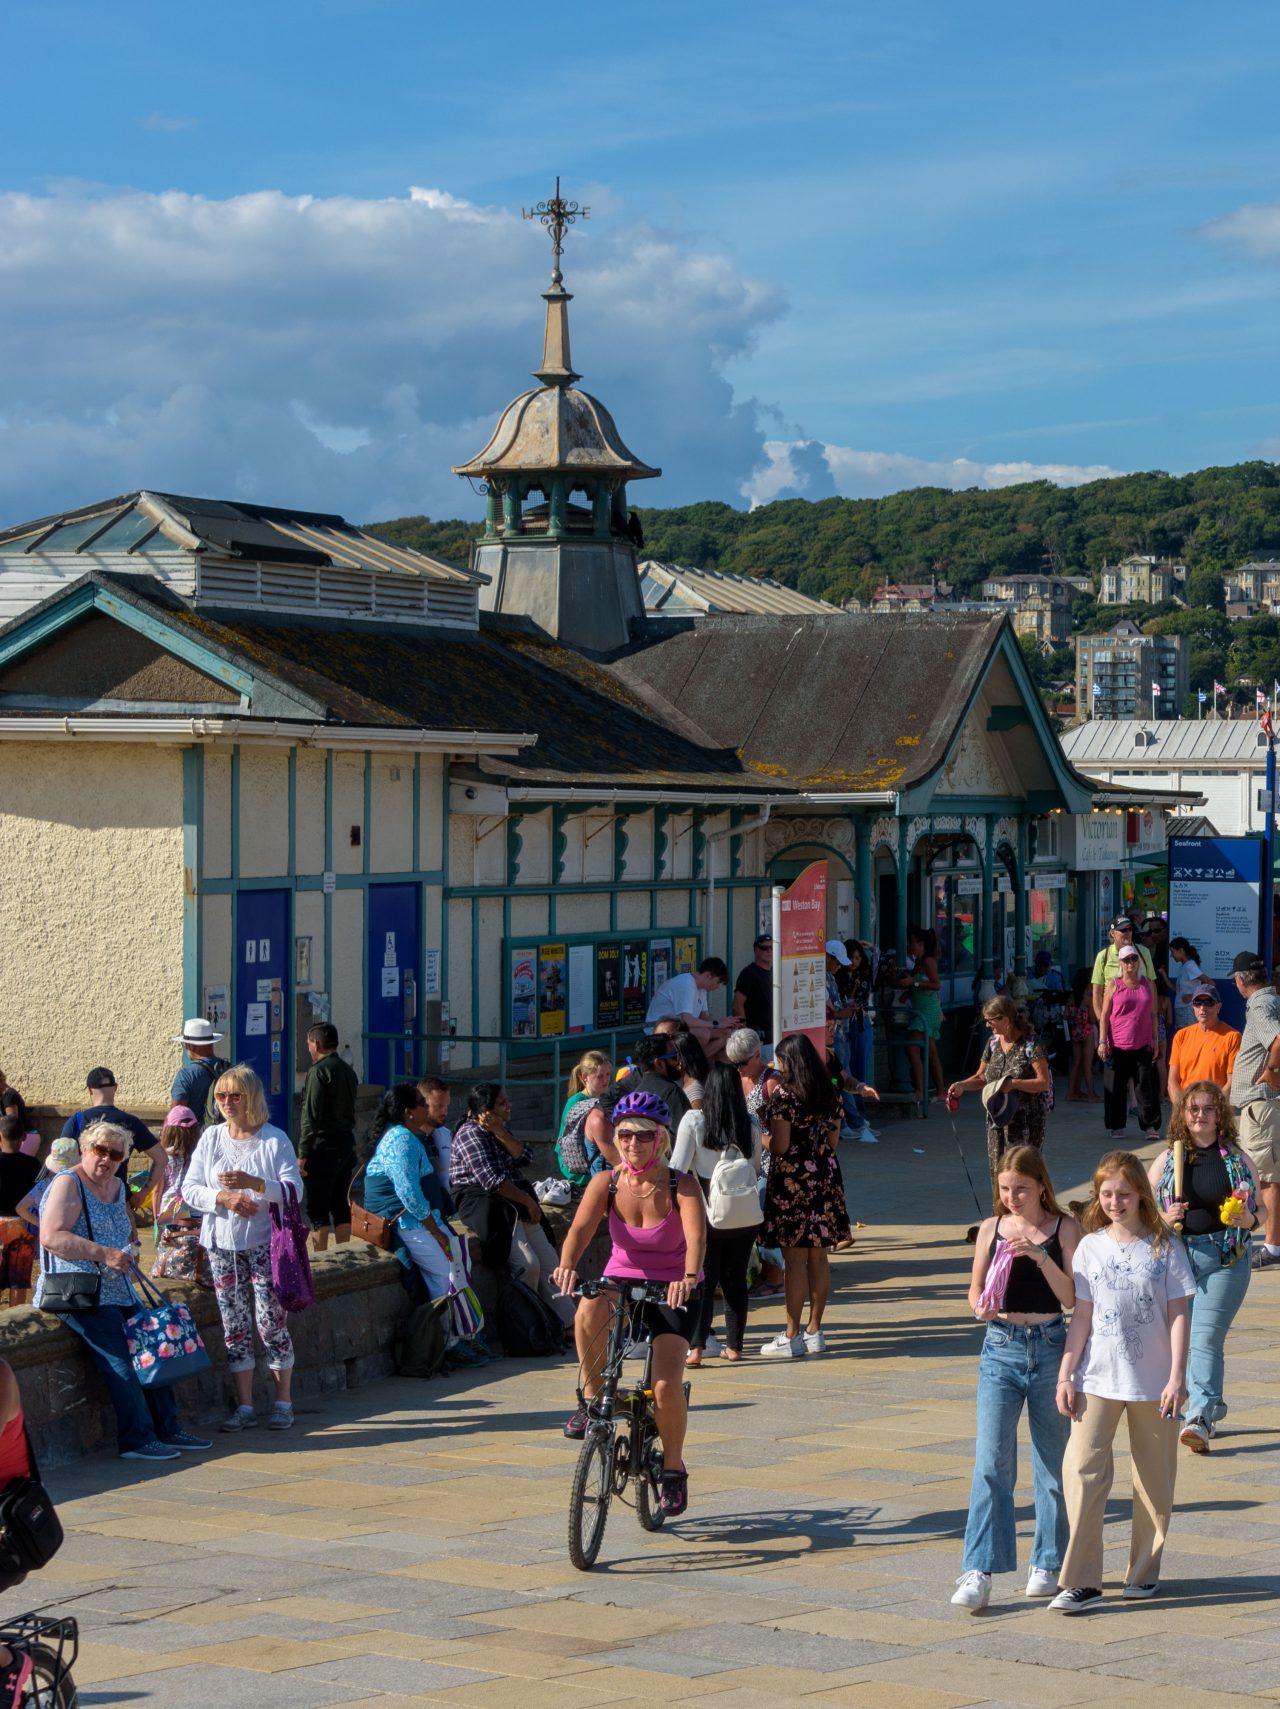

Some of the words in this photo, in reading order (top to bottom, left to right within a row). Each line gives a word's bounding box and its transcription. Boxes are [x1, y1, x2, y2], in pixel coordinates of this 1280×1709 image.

[1082, 815, 1118, 839] Victorian
[793, 900, 811, 911] Weston
[811, 899, 820, 911] Bay
